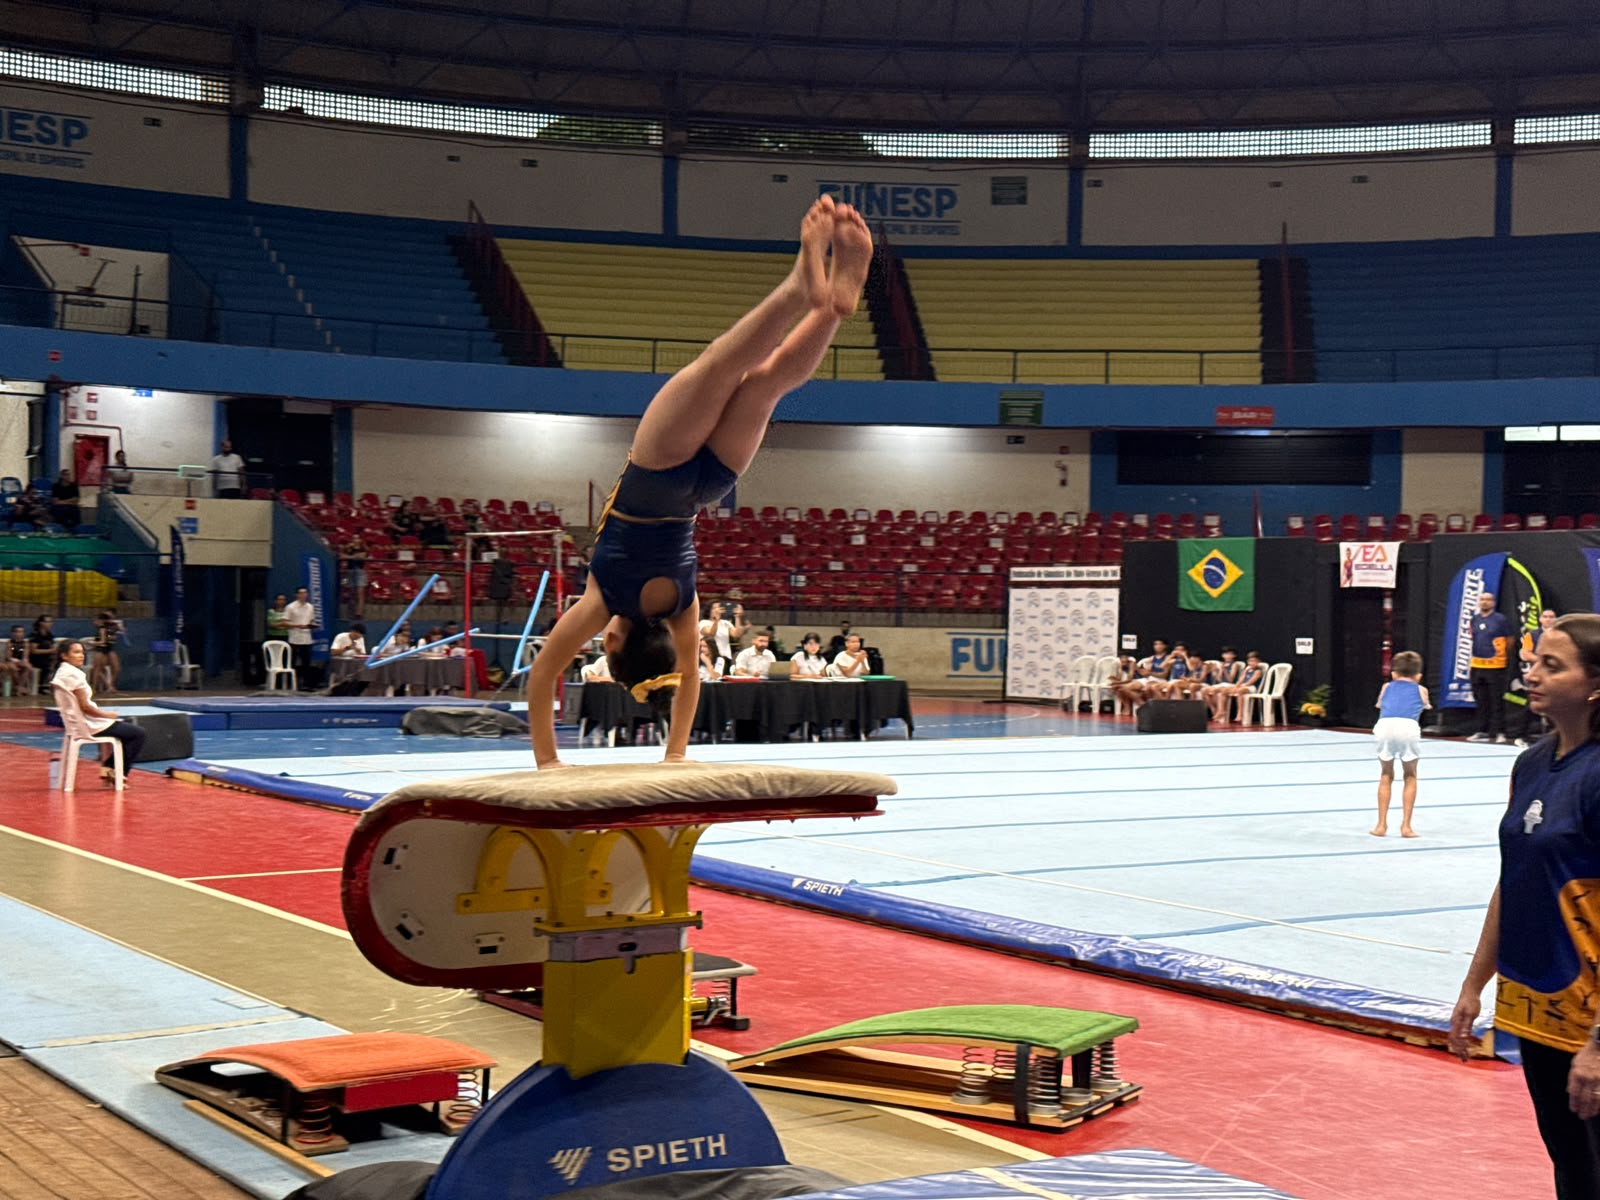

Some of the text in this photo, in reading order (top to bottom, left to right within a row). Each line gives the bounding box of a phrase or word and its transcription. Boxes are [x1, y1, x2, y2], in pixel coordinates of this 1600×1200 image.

[0, 110, 88, 147] ESP
[803, 880, 844, 897] SPIETH
[607, 1133, 728, 1173] SPIETH
